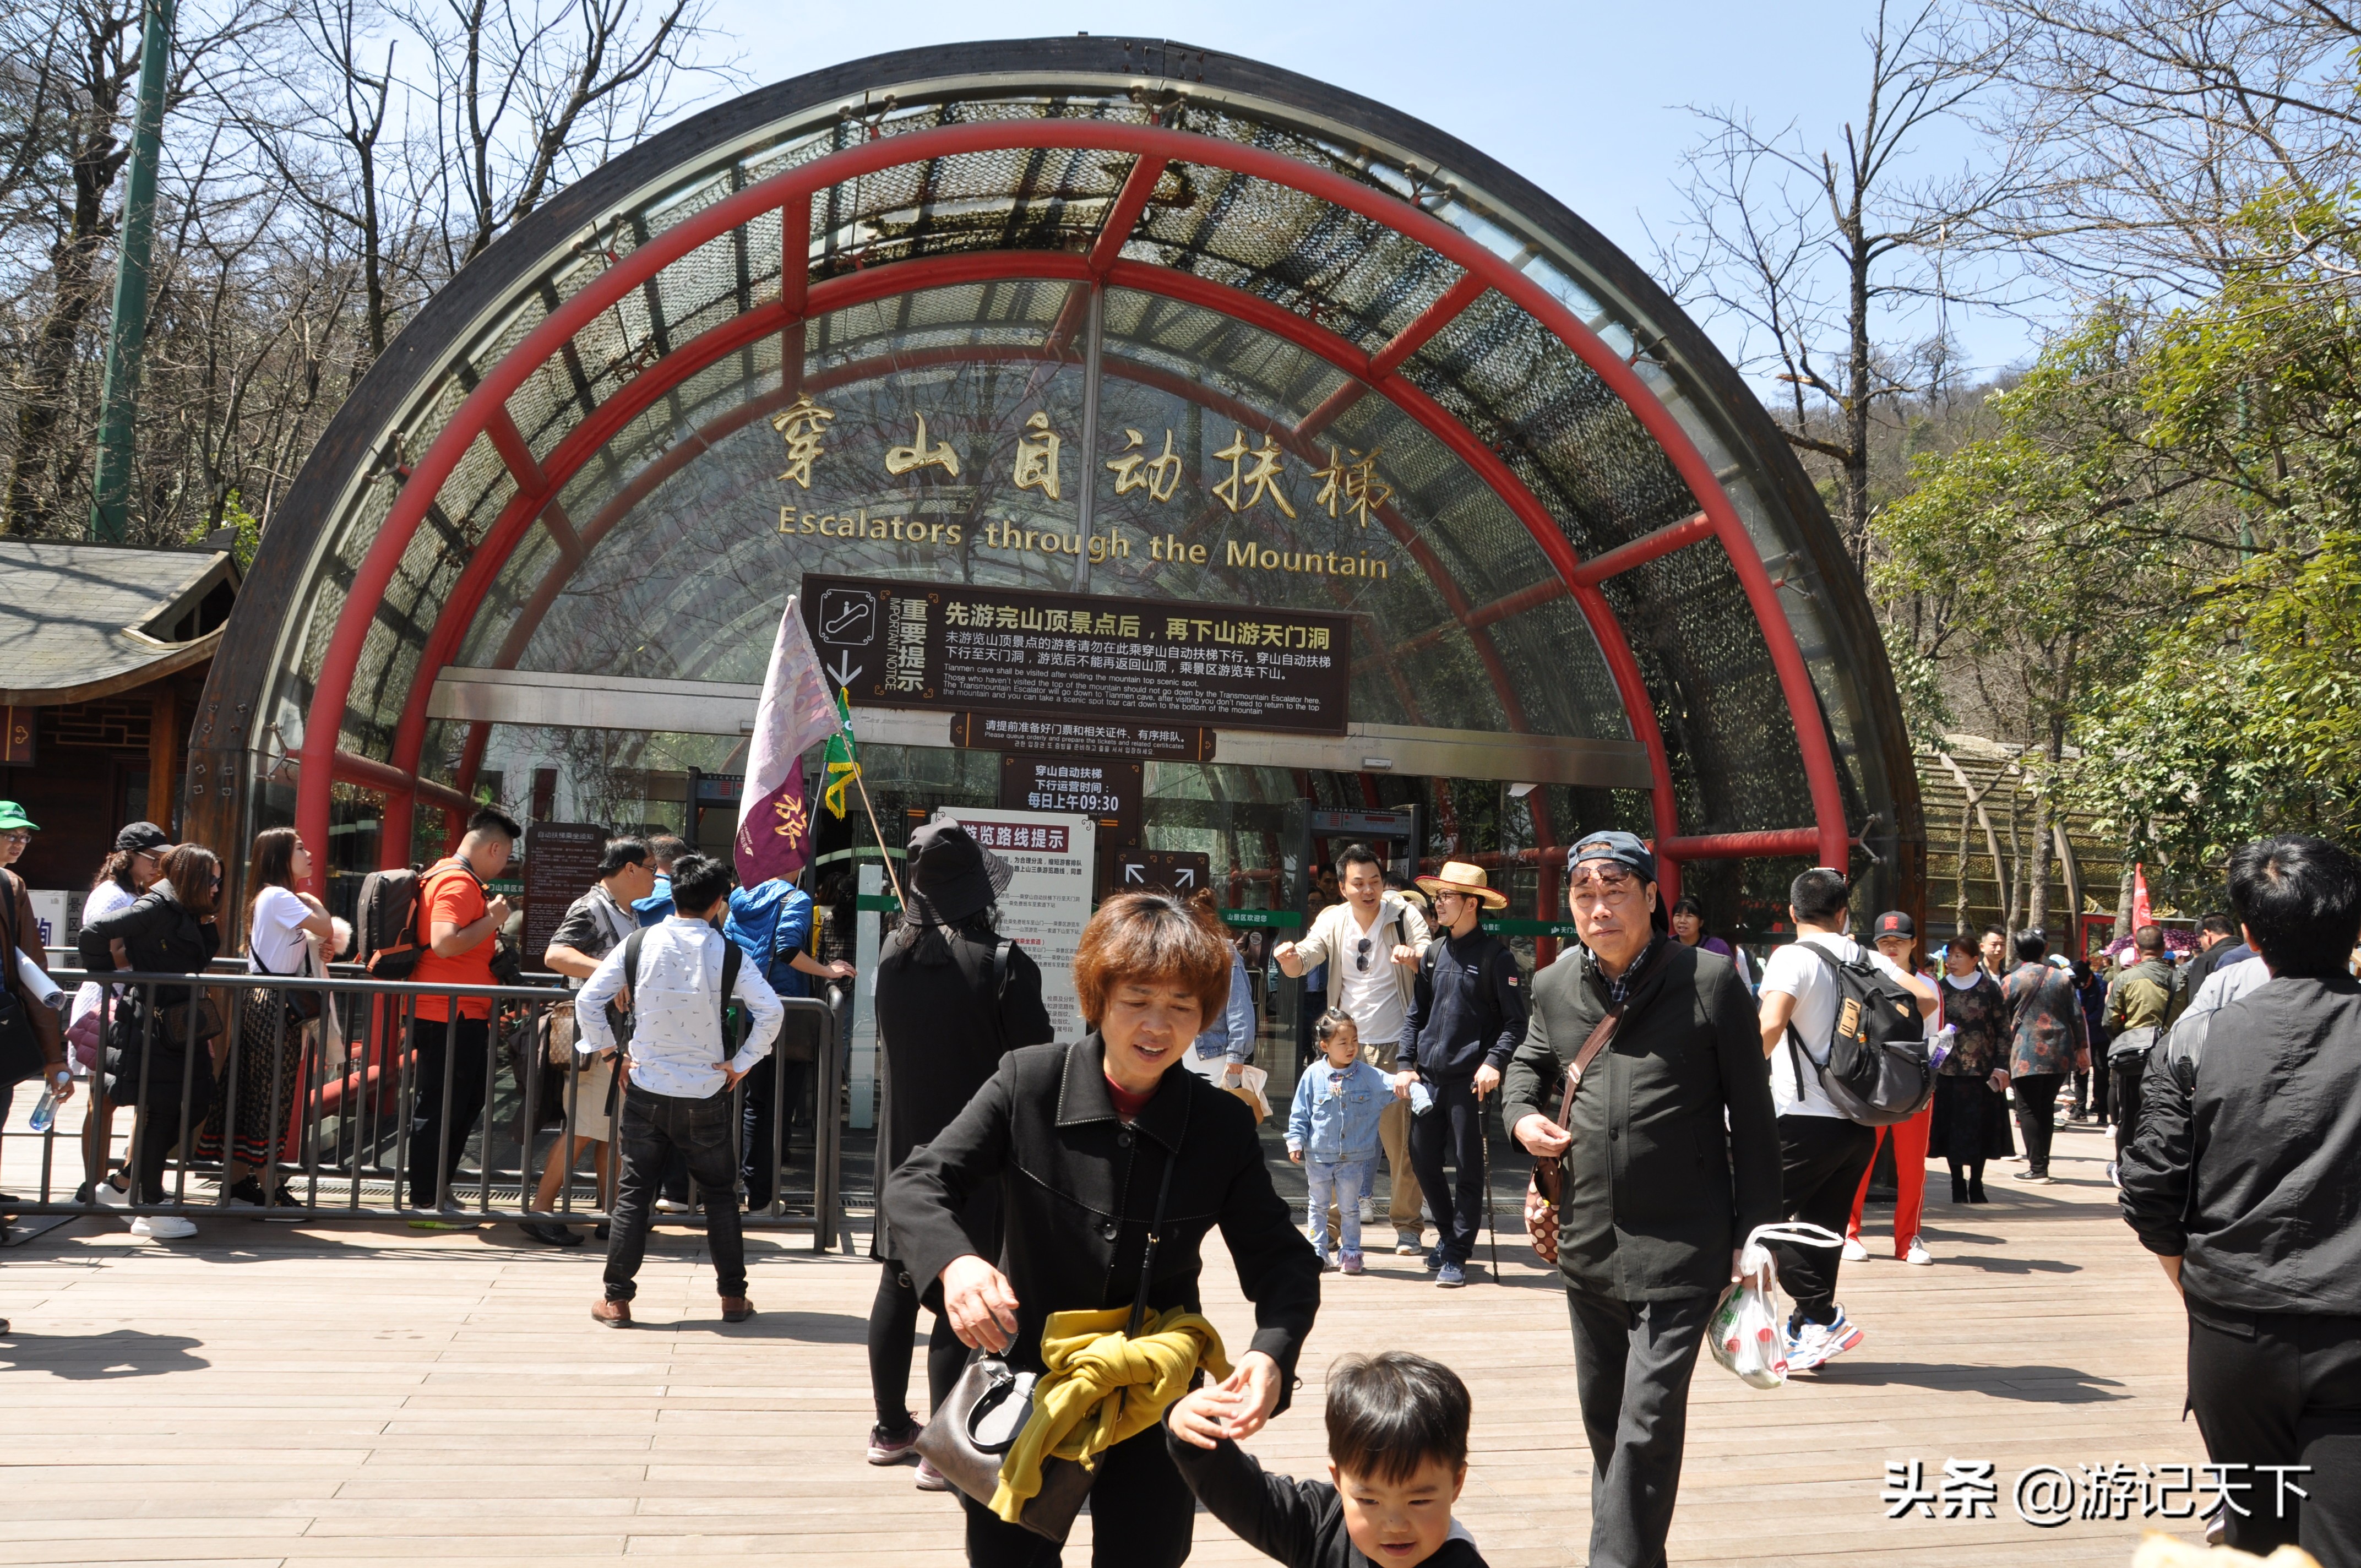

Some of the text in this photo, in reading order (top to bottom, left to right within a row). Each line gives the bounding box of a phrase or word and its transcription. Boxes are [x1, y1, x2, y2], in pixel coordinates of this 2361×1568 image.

[771, 391, 1395, 529] 穿山自动扶梯
[778, 505, 1388, 580] Escalators through the Mountain
[945, 602, 1330, 650] 先游完山顶景点后，再下山游天门洞
[885, 597, 901, 690] IMPORTANT NOTICE
[897, 599, 928, 692] 重要提示
[945, 631, 1331, 668] 未游览山顶景点的游客请勿在此乘穿山自动扶梯下行。穿山自动扶梯
[945, 646, 1286, 680] 下行至天门洞，游览后不能再返回山顶，乘景区游览车下山。
[945, 664, 974, 672] Tianmen
[1069, 672, 1092, 682] visiting
[1143, 677, 1155, 685] top
[960, 682, 1011, 692] Transmountain
[1014, 685, 1046, 694] Escalator
[1175, 696, 1199, 705] visiting
[1308, 704, 1319, 712] top
[1052, 680, 1063, 689] top
[1195, 689, 1204, 698] by
[1220, 691, 1269, 700] Transmountain
[1271, 694, 1302, 703] Escalator
[1088, 698, 1103, 706] spot
[986, 719, 1184, 742] 请提前准备好门票和相关证件、有序排队。
[1035, 765, 1102, 779] 穿山自动扶梯
[1035, 780, 1109, 793] 下行运营时间：
[1028, 792, 1118, 811] 每日上午09:30
[1227, 913, 1267, 922] 山景区欢迎您
